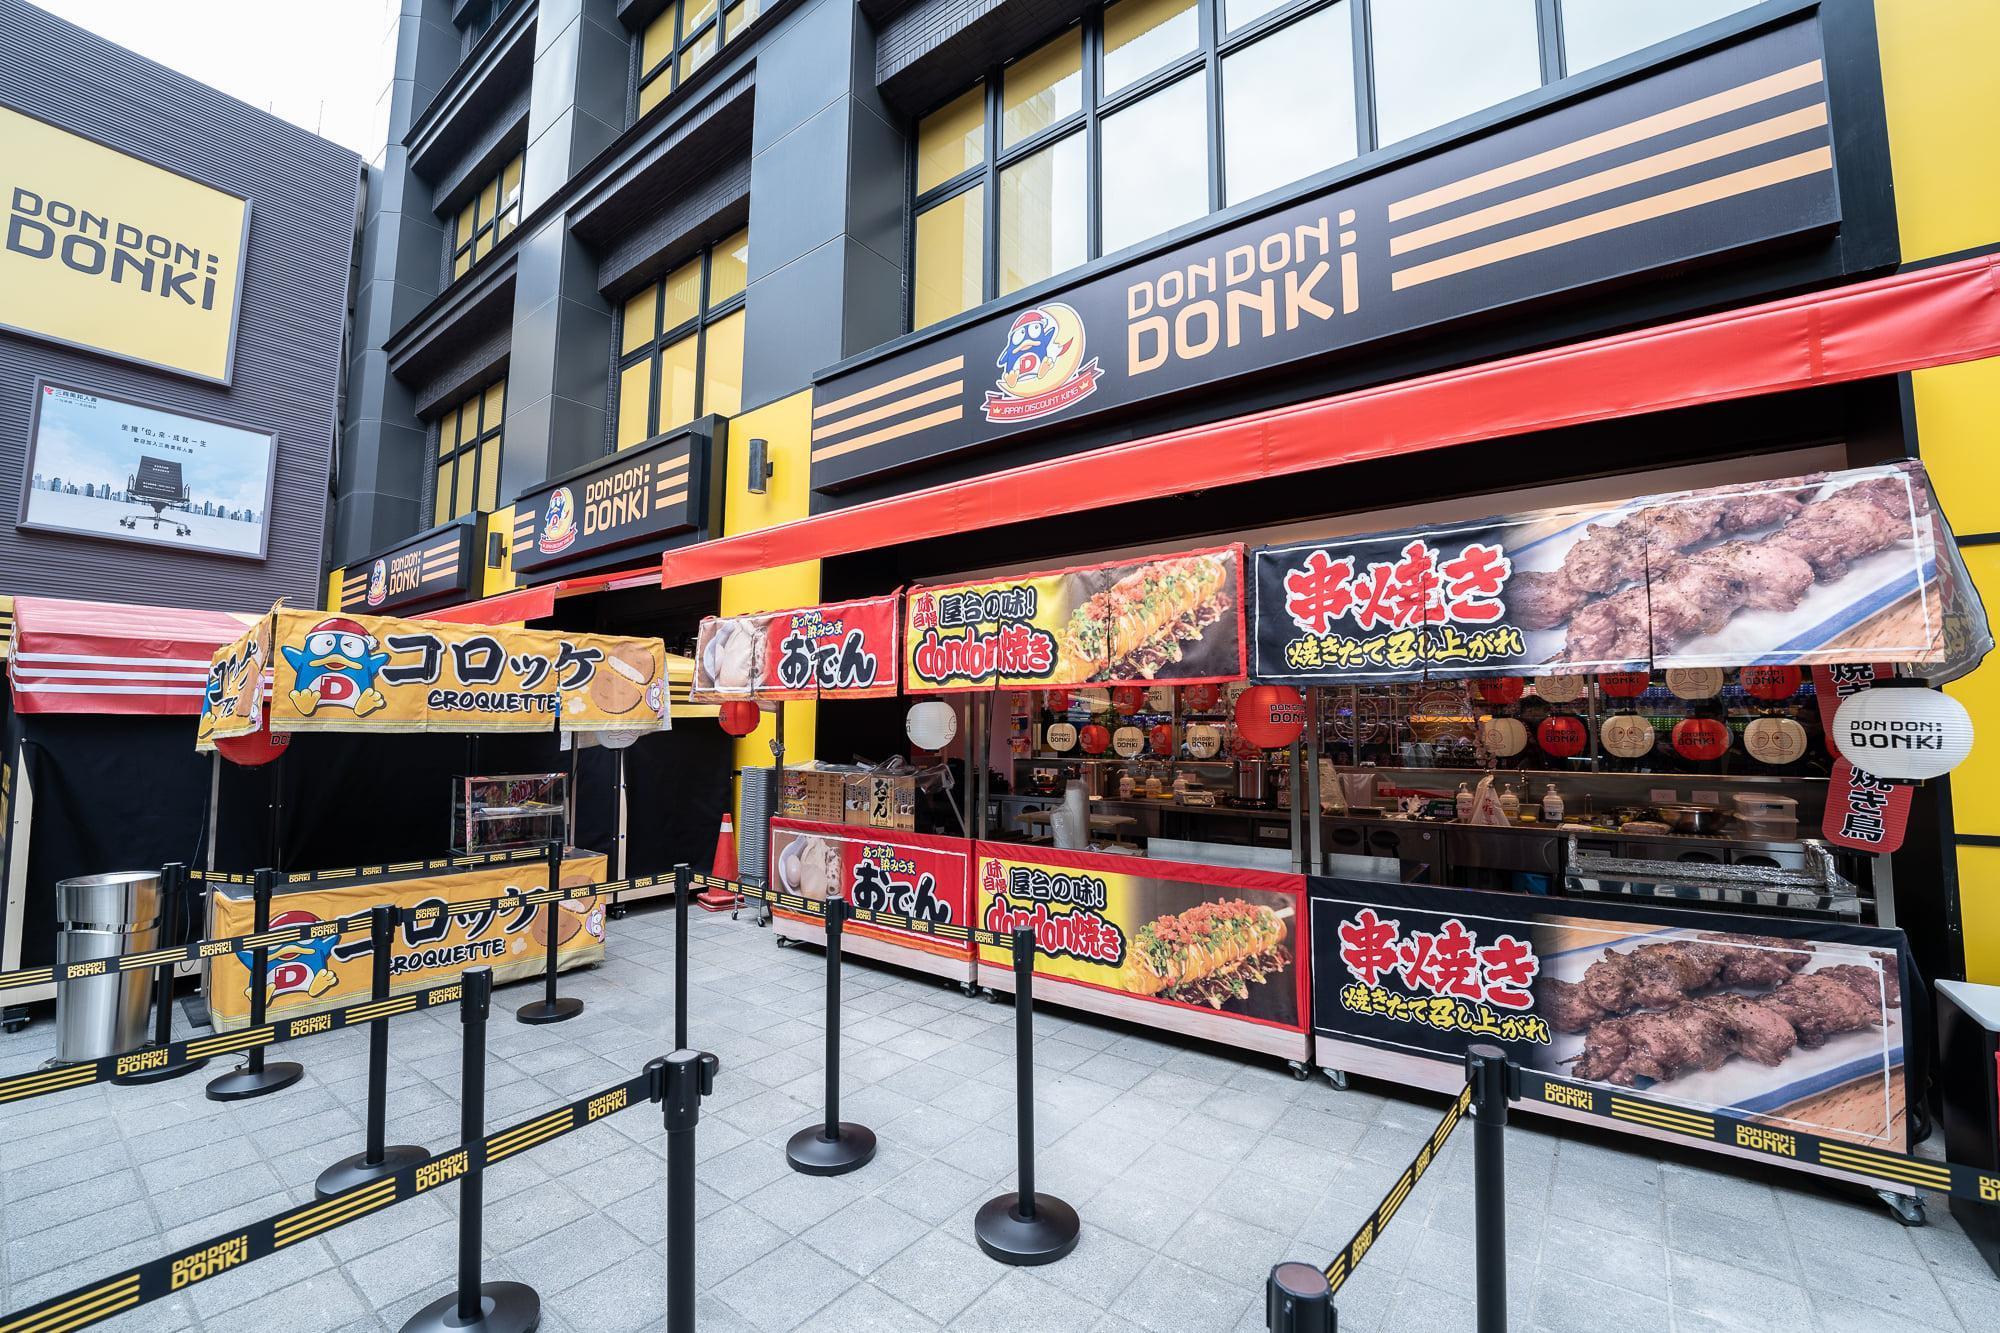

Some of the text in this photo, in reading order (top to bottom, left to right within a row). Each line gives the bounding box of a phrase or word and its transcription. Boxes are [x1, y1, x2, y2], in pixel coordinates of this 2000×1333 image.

[1001, 386, 1079, 415] JAPAN DISCOUNT KING
[1285, 540, 1512, 635] 串焼き
[379, 633, 605, 692] コロッケ
[780, 629, 878, 689] おでん
[1287, 625, 1526, 668] 焼きたて召し上がれ
[427, 688, 561, 715] CROQUETTE
[852, 859, 953, 924] おでん
[1338, 908, 1540, 1010] 串焼き
[1341, 982, 1552, 1045] 焼きたて召し上がれ
